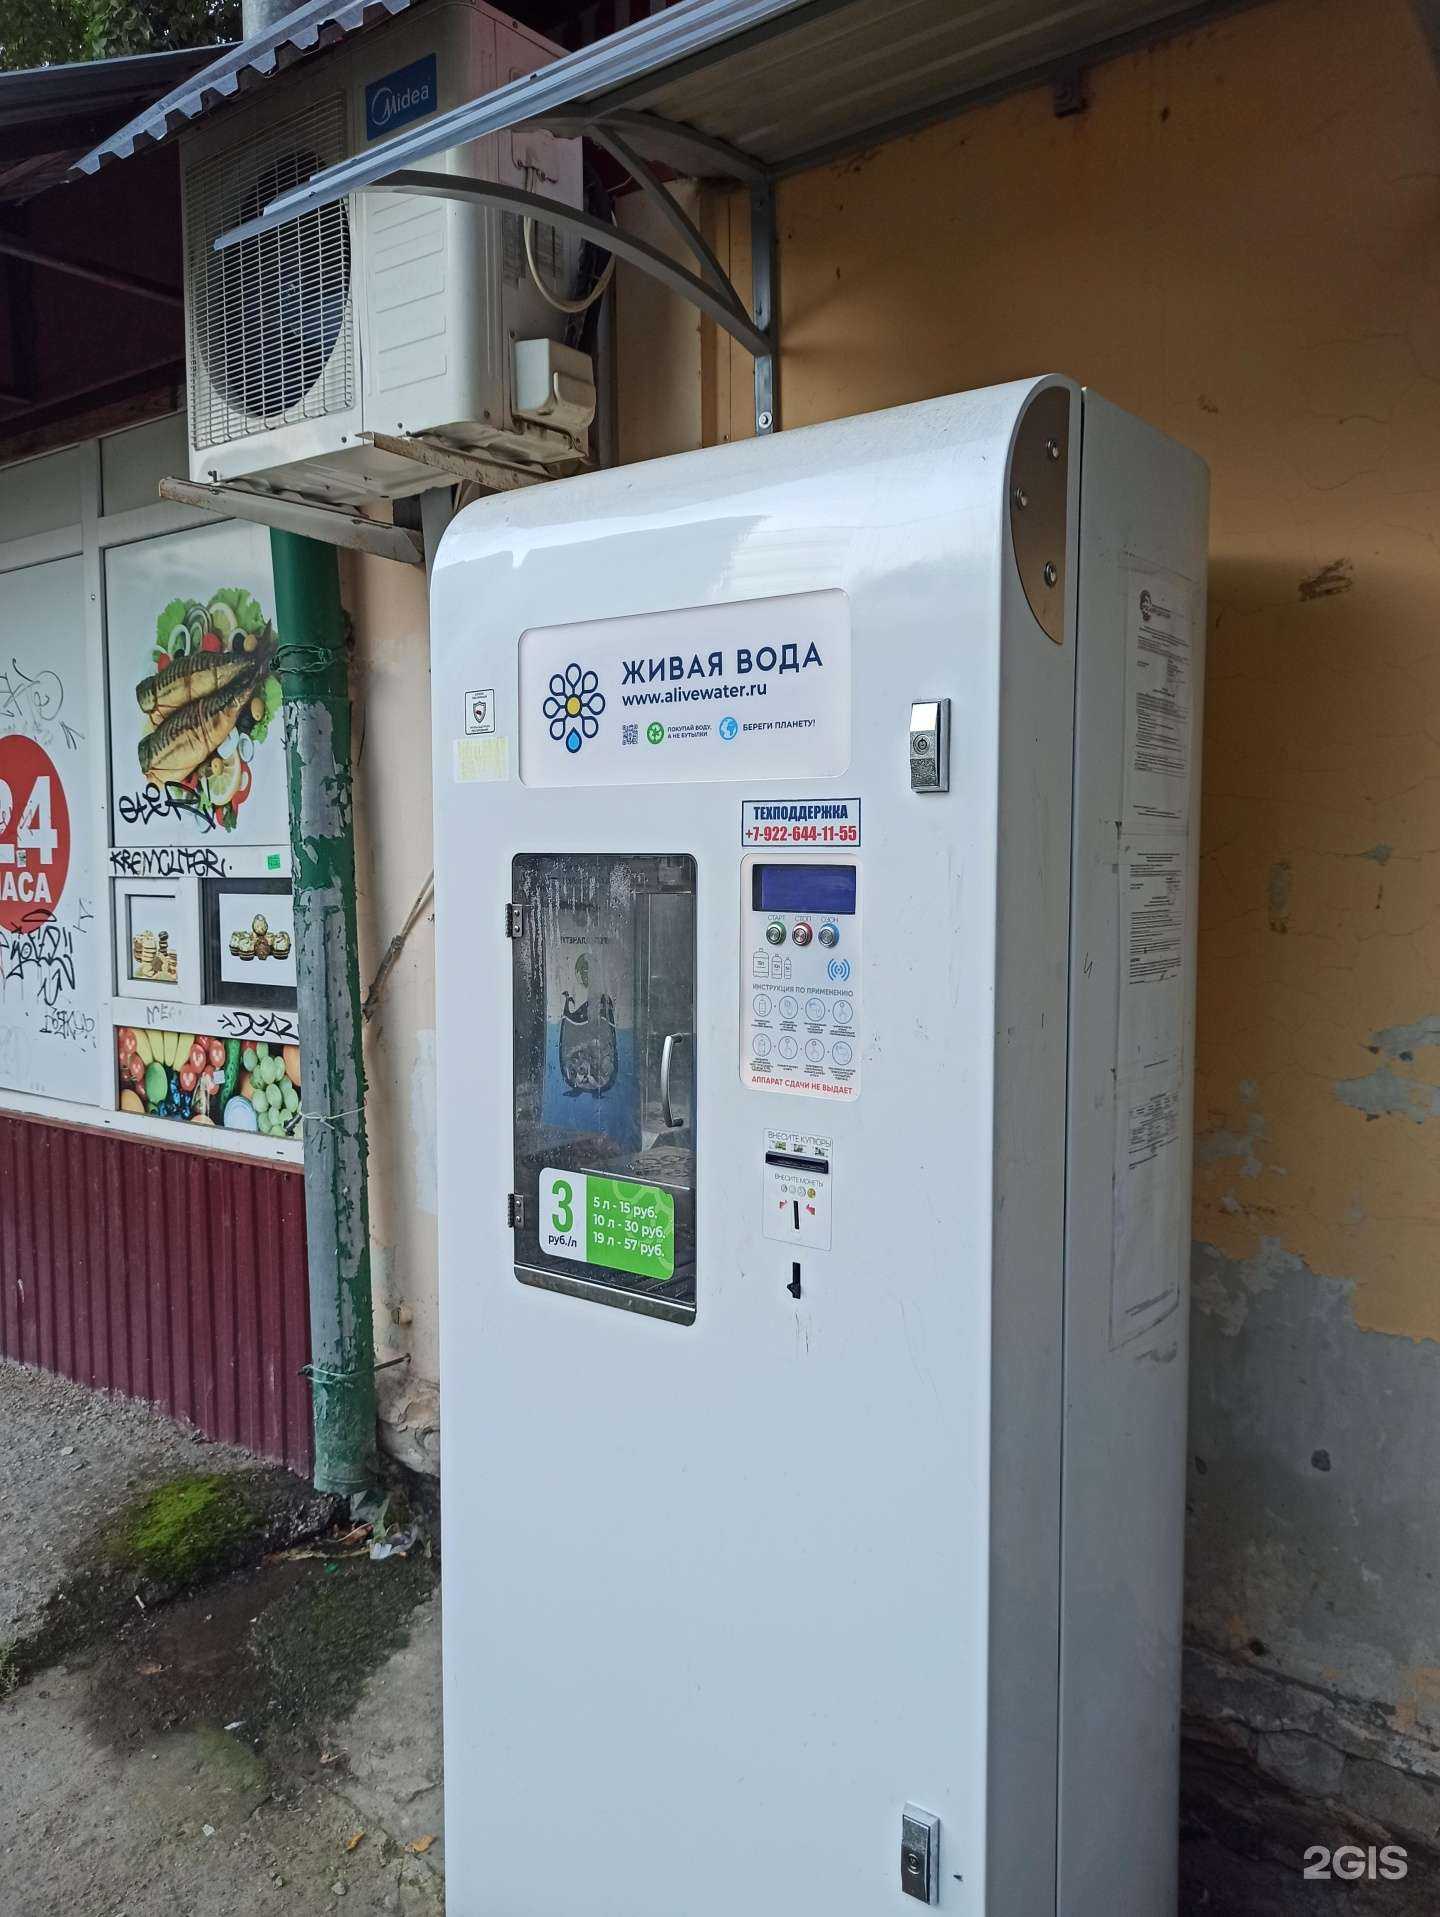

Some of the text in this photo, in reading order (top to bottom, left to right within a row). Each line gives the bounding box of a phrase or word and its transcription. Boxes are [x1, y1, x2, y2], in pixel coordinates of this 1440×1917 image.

[371, 85, 430, 125] Midea
[621, 641, 824, 685] ЖИВАЯ ВОДА
[621, 683, 768, 707] www.alivewater.ru
[742, 720, 816, 731] БЕРЕГИ ПЛАНЕТУ!
[753, 804, 848, 822] ТЕХПОДДЕРЖКА
[745, 825, 856, 842] +7-922-644-11-55
[752, 983, 854, 998] ИНСТРУКЦИЯ ПО ПРИМЕНЕНИЮ
[751, 1075, 854, 1096] АППАРАТ СДАЧИ НЕ ВЫДАЕТ
[552, 1180, 574, 1233] 3
[593, 1197, 600, 1208] 5
[602, 1201, 610, 1210] л
[620, 1201, 631, 1213] 15
[633, 1205, 658, 1219] руб.
[593, 1214, 605, 1226] 10
[607, 1219, 615, 1228] л
[624, 1220, 639, 1233] 30
[641, 1225, 666, 1239] руб.
[548, 1235, 577, 1247] руб./л
[593, 1232, 605, 1244] 19
[606, 1237, 615, 1246] л
[624, 1238, 638, 1251] 57
[640, 1243, 665, 1257] руб.
